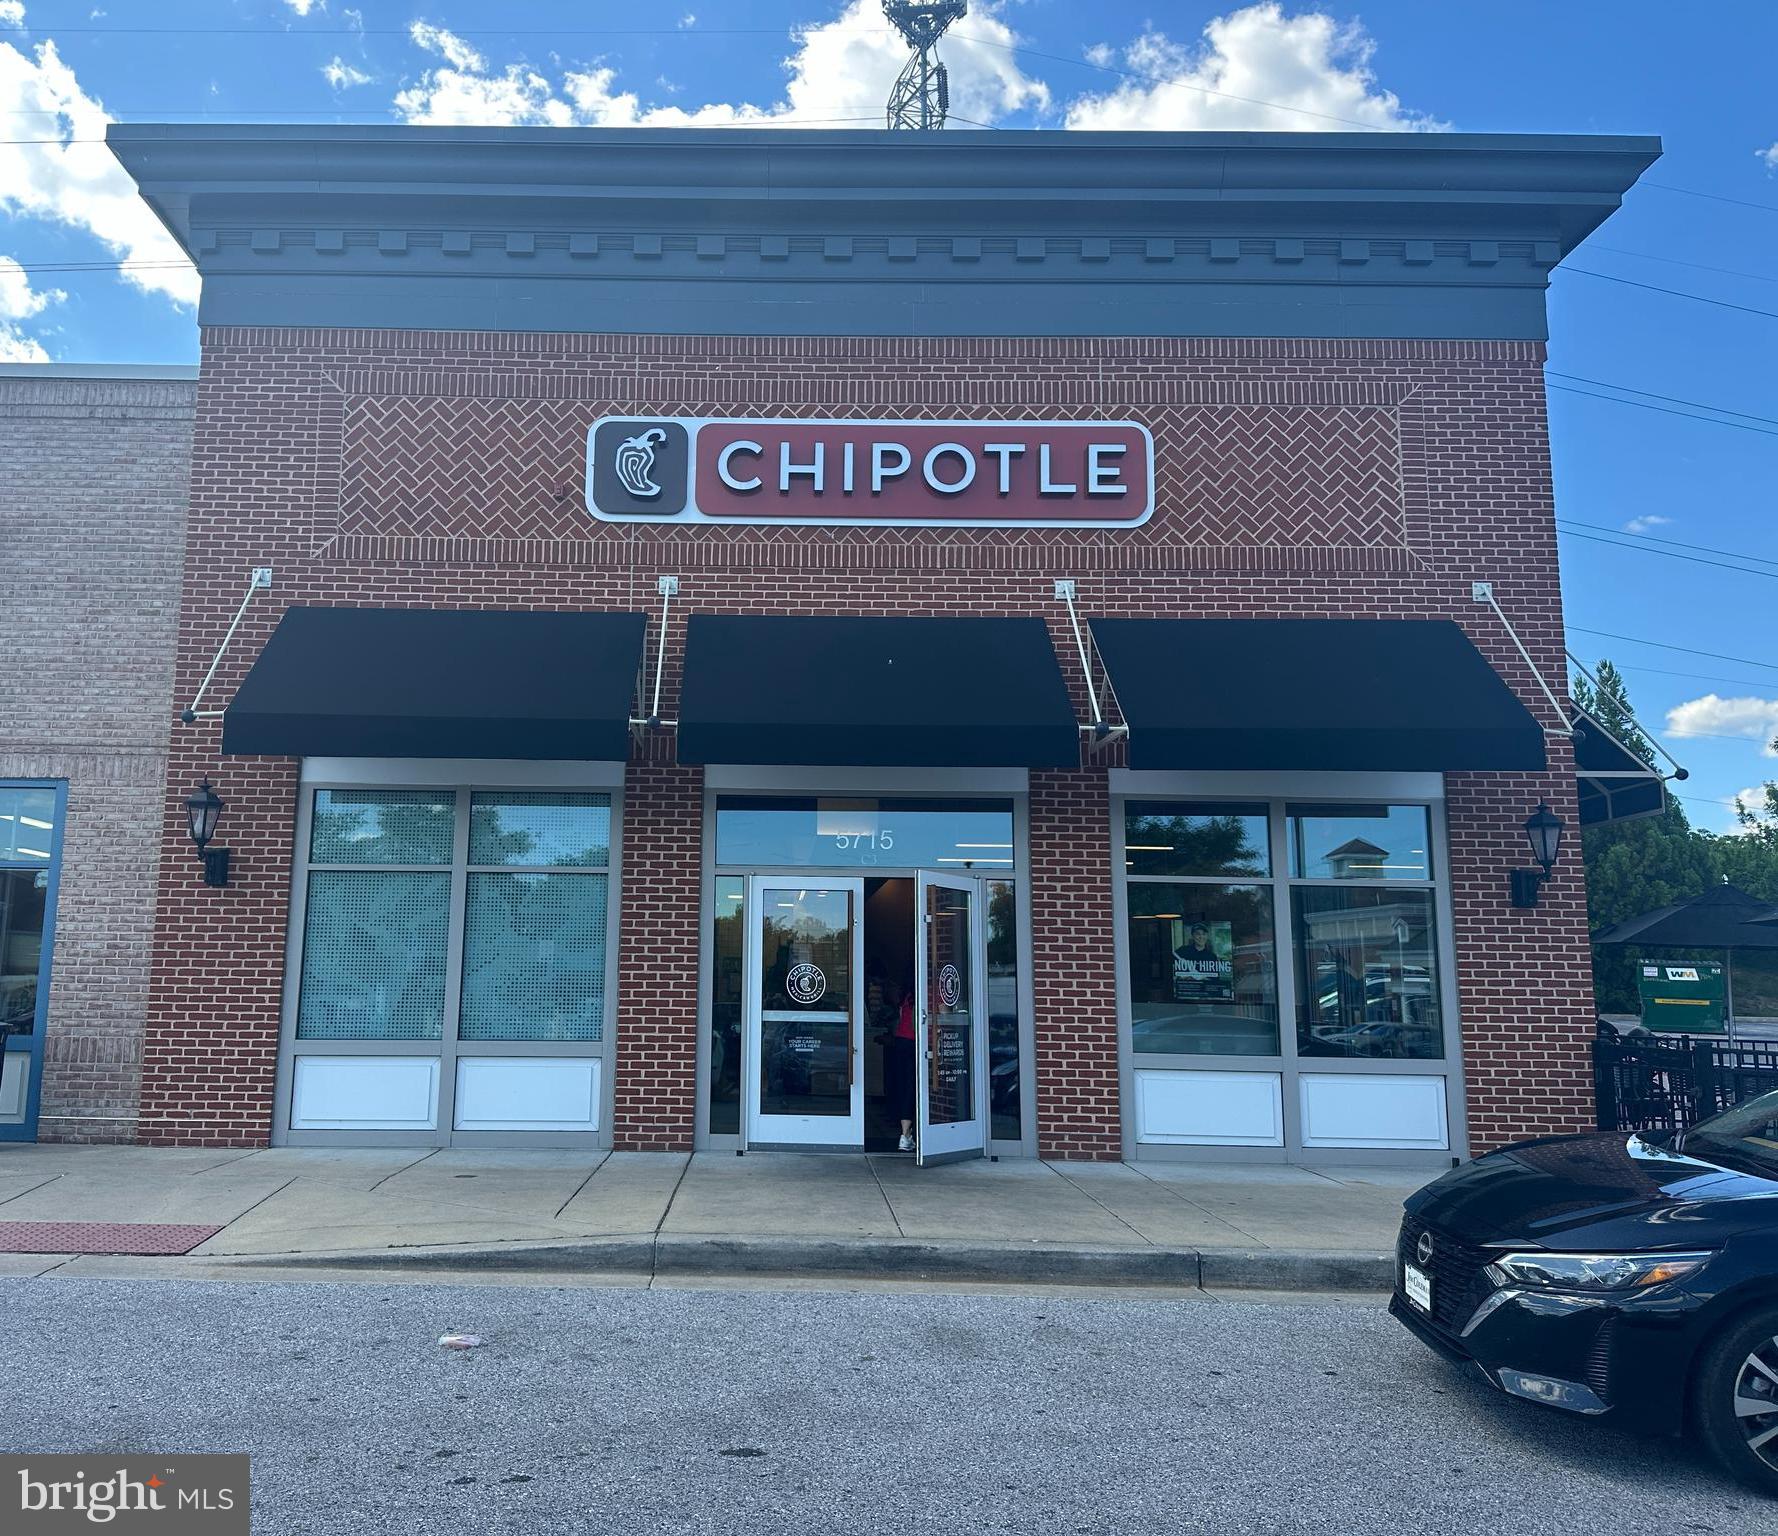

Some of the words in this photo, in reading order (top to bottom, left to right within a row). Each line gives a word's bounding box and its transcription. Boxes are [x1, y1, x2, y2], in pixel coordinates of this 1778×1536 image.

[717, 439, 1128, 495] CHIPOTLE
[835, 829, 894, 850] 5715
[789, 965, 824, 982] CHIPOTLE
[1174, 959, 1197, 972] NOW
[1199, 960, 1232, 973] HIRING
